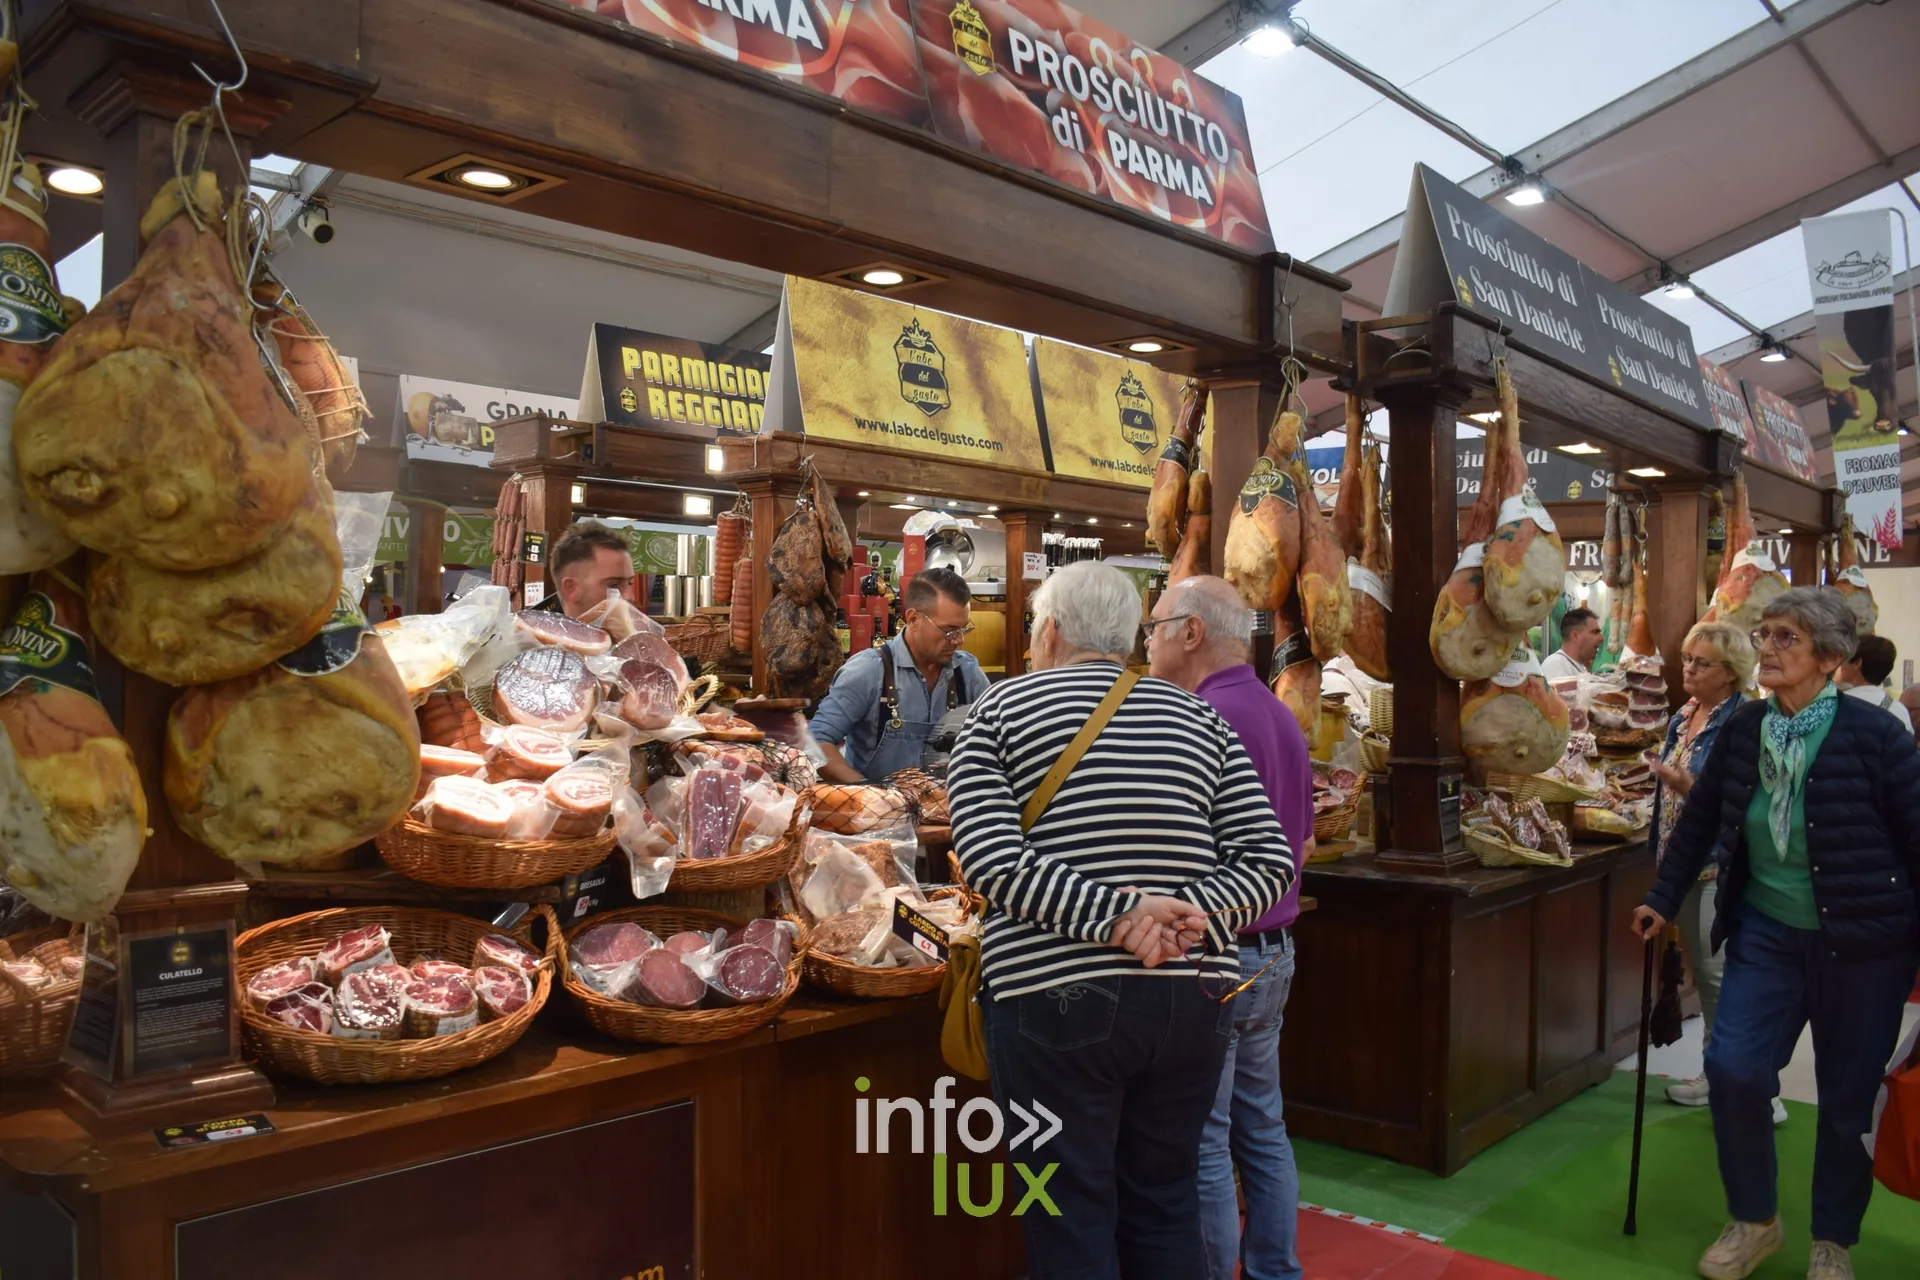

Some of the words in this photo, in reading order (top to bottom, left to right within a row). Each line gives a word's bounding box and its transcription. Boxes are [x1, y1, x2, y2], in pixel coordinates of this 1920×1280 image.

[1008, 27, 1229, 165] PROSCIUTTO
[1052, 107, 1085, 154] di
[1107, 129, 1214, 206] PARMA
[1444, 201, 1554, 294] Prosciutto
[1557, 271, 1578, 308] di
[1469, 265, 1513, 318] San
[1511, 287, 1586, 354] Daniele
[1596, 292, 1675, 360] Prosciutto
[1677, 338, 1692, 369] di
[909, 350, 933, 366] l'abc
[918, 370, 930, 383] del
[1615, 344, 1649, 385] San
[1645, 359, 1699, 409] Daniele
[913, 388, 940, 404] gusto
[855, 417, 1004, 452] www.labcdelgusto.com
[913, 914, 937, 933] LARDO
[159, 967, 203, 980] CULATELLO
